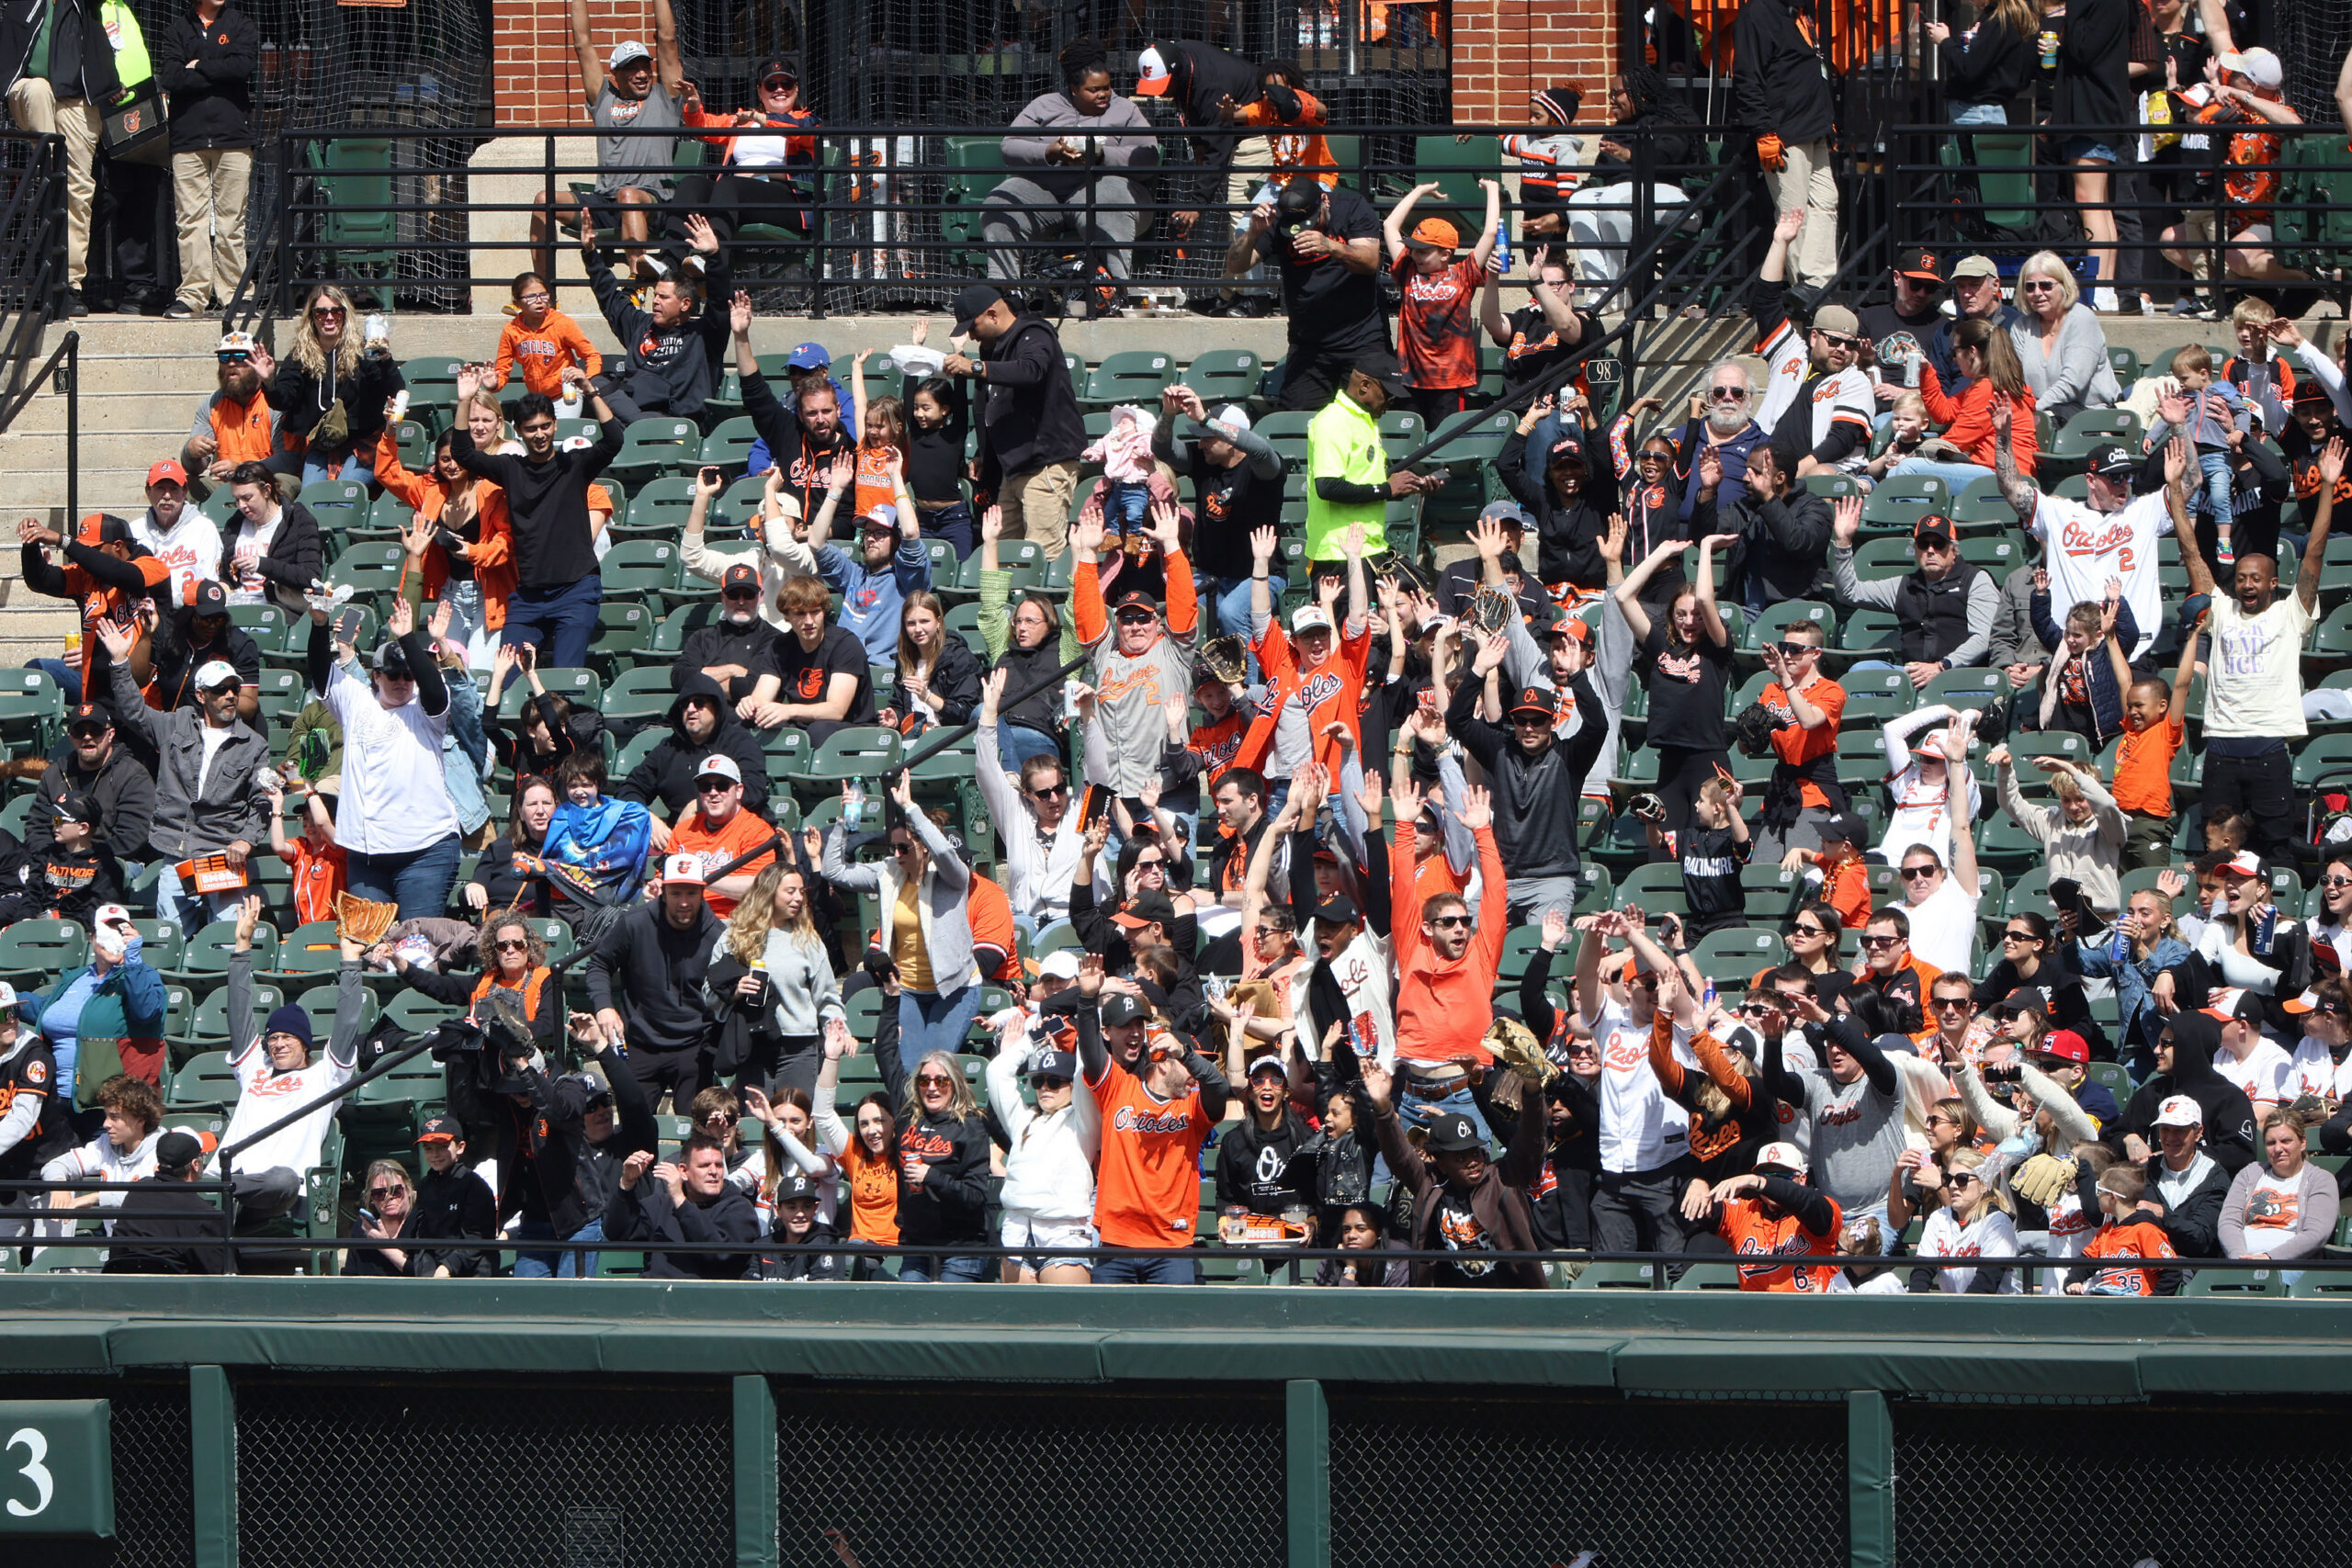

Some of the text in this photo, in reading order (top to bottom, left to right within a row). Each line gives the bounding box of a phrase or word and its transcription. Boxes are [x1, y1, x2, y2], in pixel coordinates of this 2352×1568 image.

[1596, 361, 1612, 381] 98
[2119, 547, 2136, 571] 2
[1684, 855, 1734, 877] BALTIMORE
[1123, 997, 1135, 1012] B
[1114, 1105, 1189, 1134] Orioles
[1457, 1121, 1472, 1138] O's
[794, 1177, 807, 1191] B
[1792, 1264, 1808, 1291] 6
[2115, 1274, 2143, 1292] 35
[6, 1427, 54, 1517] 3
